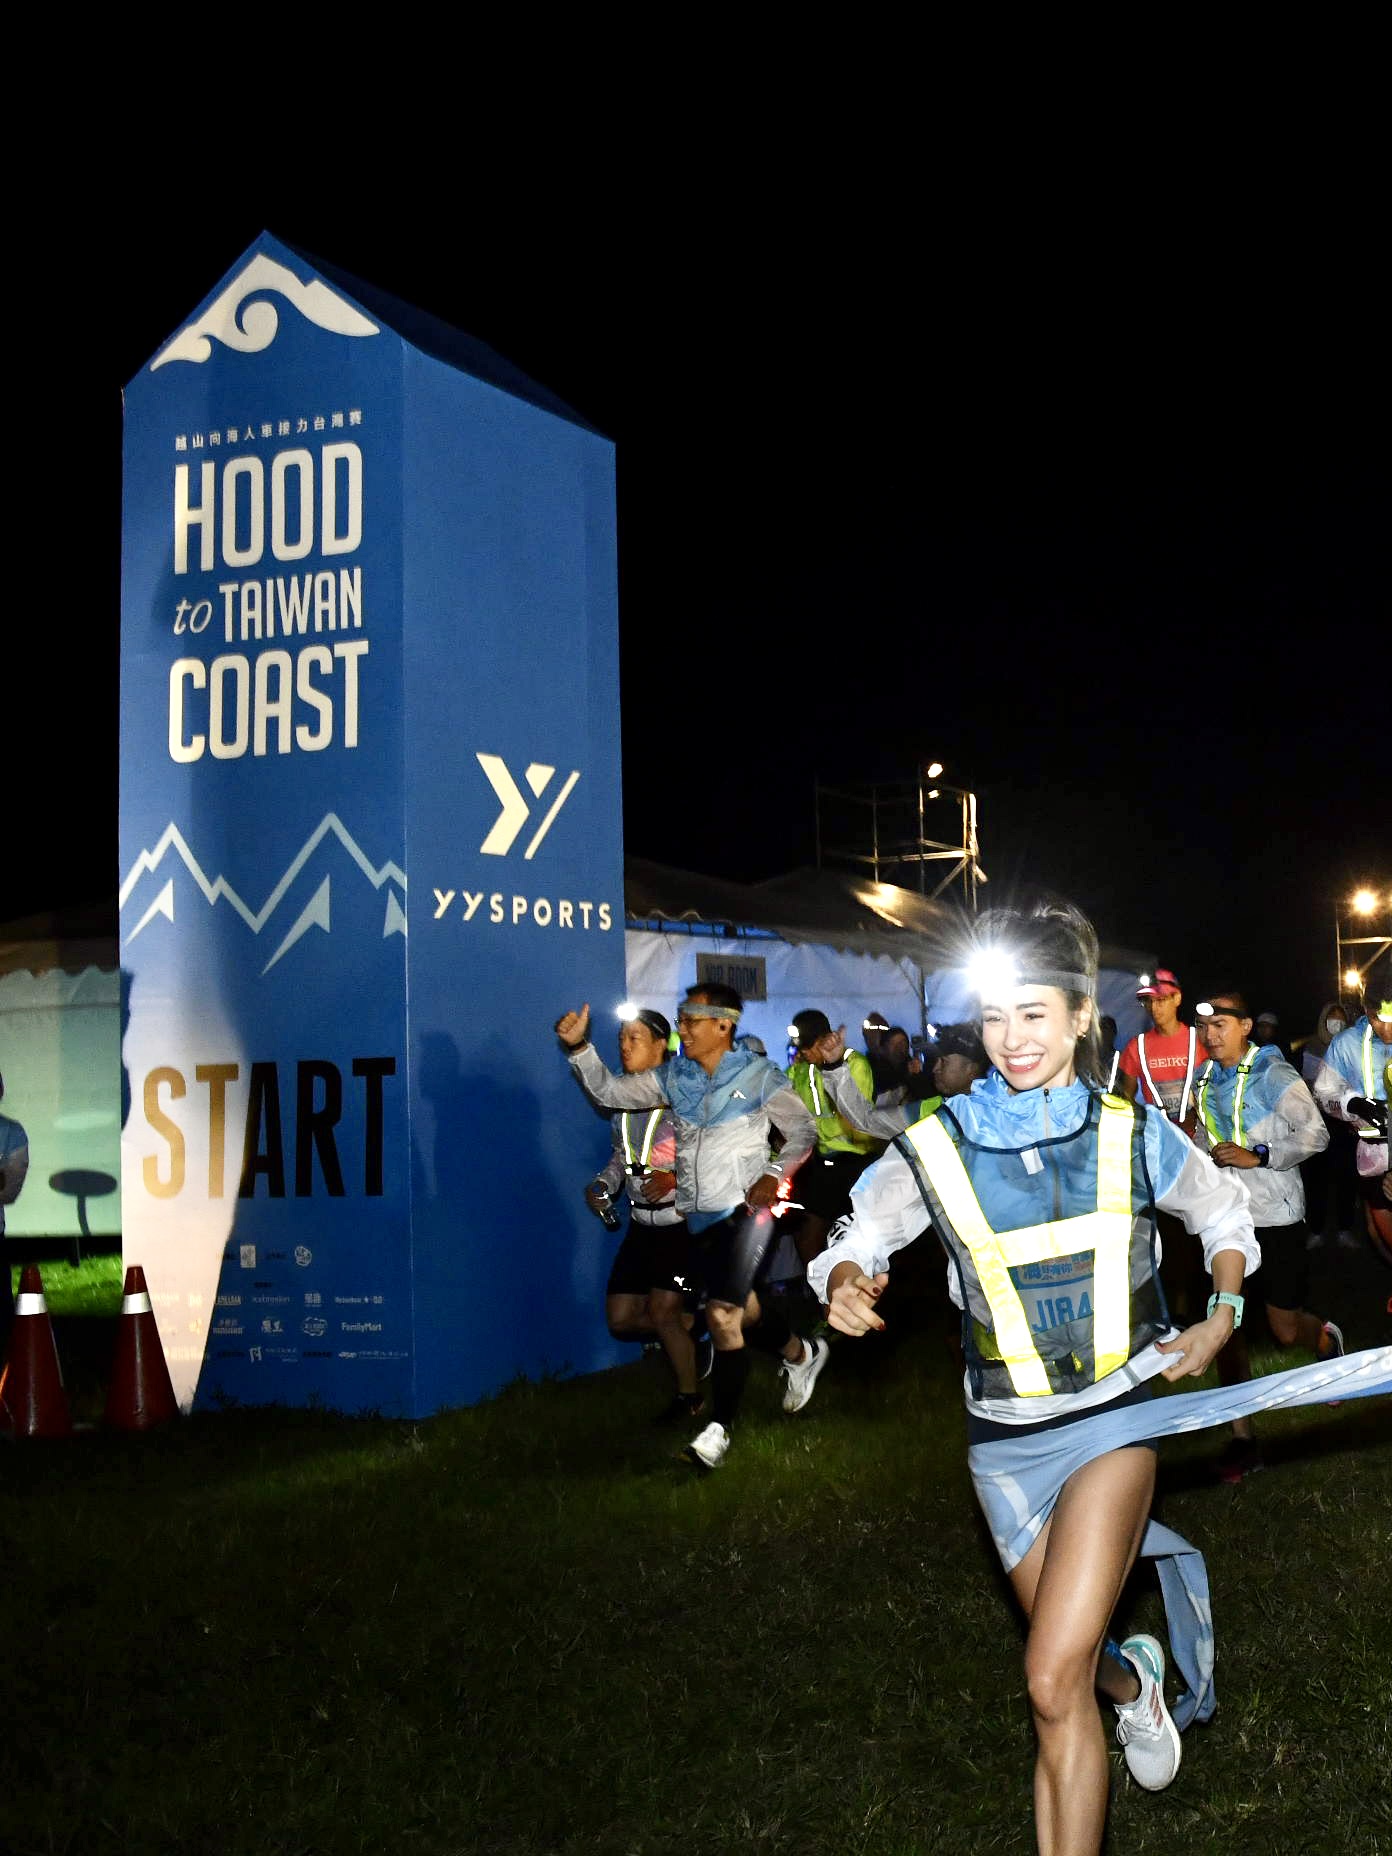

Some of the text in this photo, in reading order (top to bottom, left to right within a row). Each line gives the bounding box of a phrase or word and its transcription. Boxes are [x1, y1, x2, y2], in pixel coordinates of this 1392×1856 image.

[174, 441, 363, 575] HOOD
[173, 567, 363, 643] to TAIWAN
[168, 639, 369, 764] COAST
[143, 1057, 396, 1199] START
